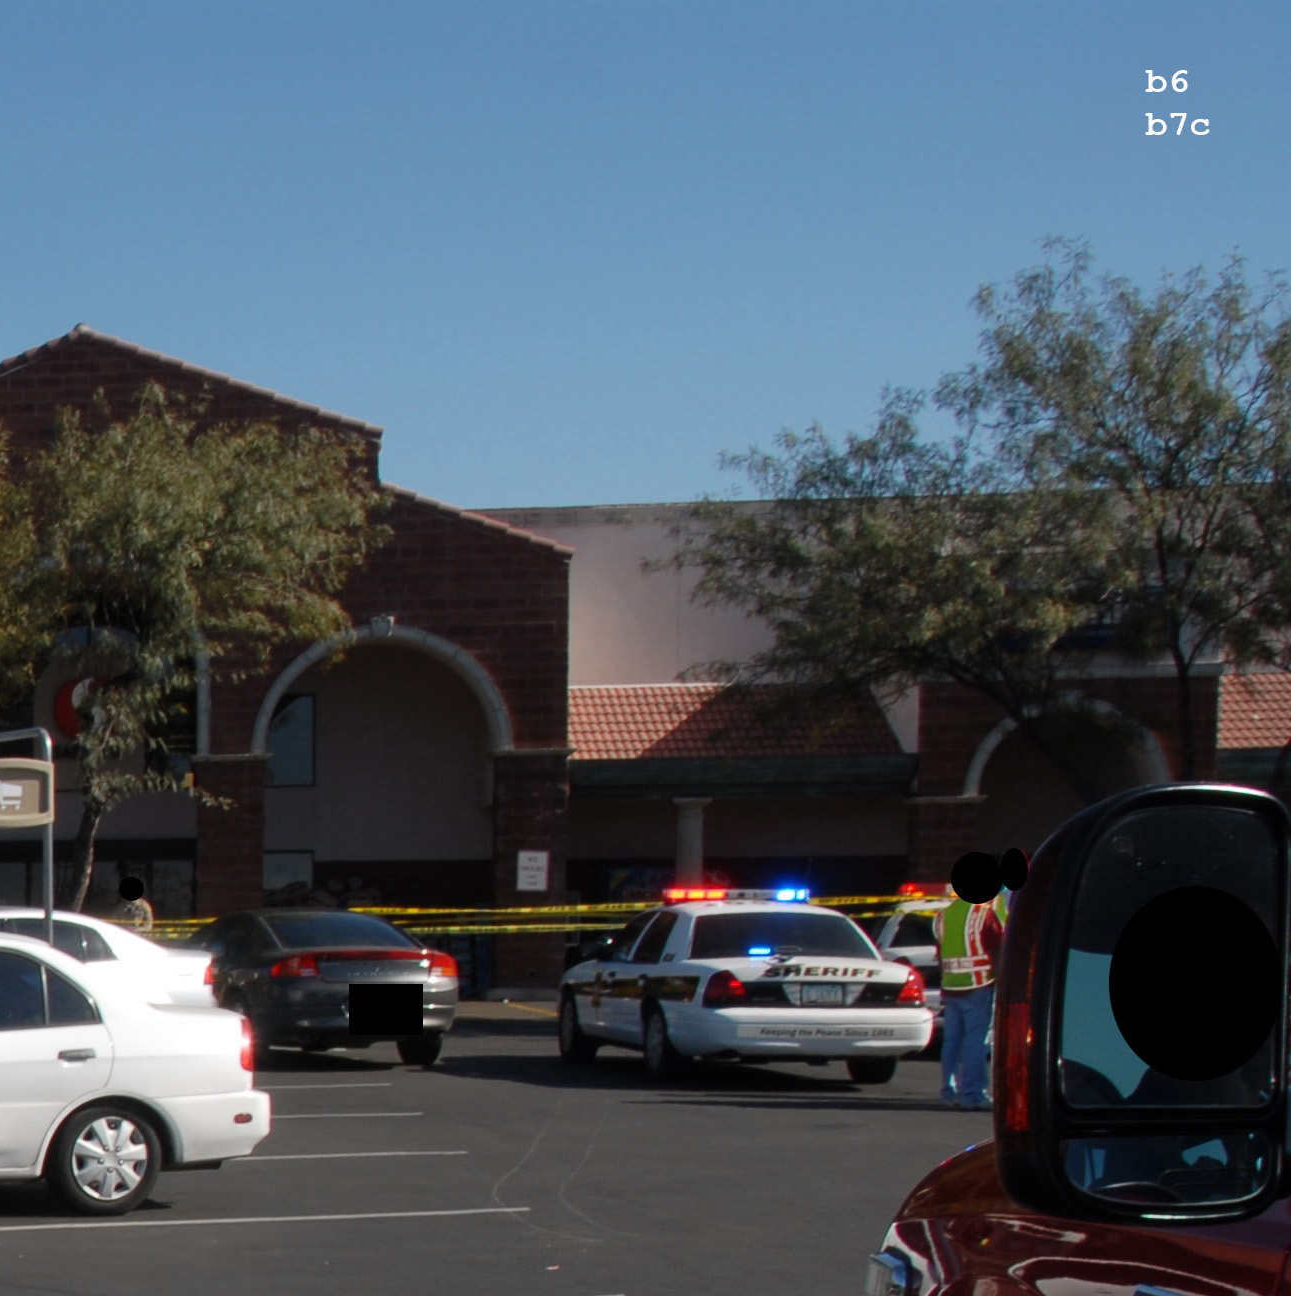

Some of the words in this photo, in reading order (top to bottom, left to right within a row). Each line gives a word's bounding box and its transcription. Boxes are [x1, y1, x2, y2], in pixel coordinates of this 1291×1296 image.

[763, 963, 882, 978] SHERIFF
[798, 1028, 812, 1036] the
[815, 1028, 842, 1037] Peace
[844, 1028, 868, 1037] Since
